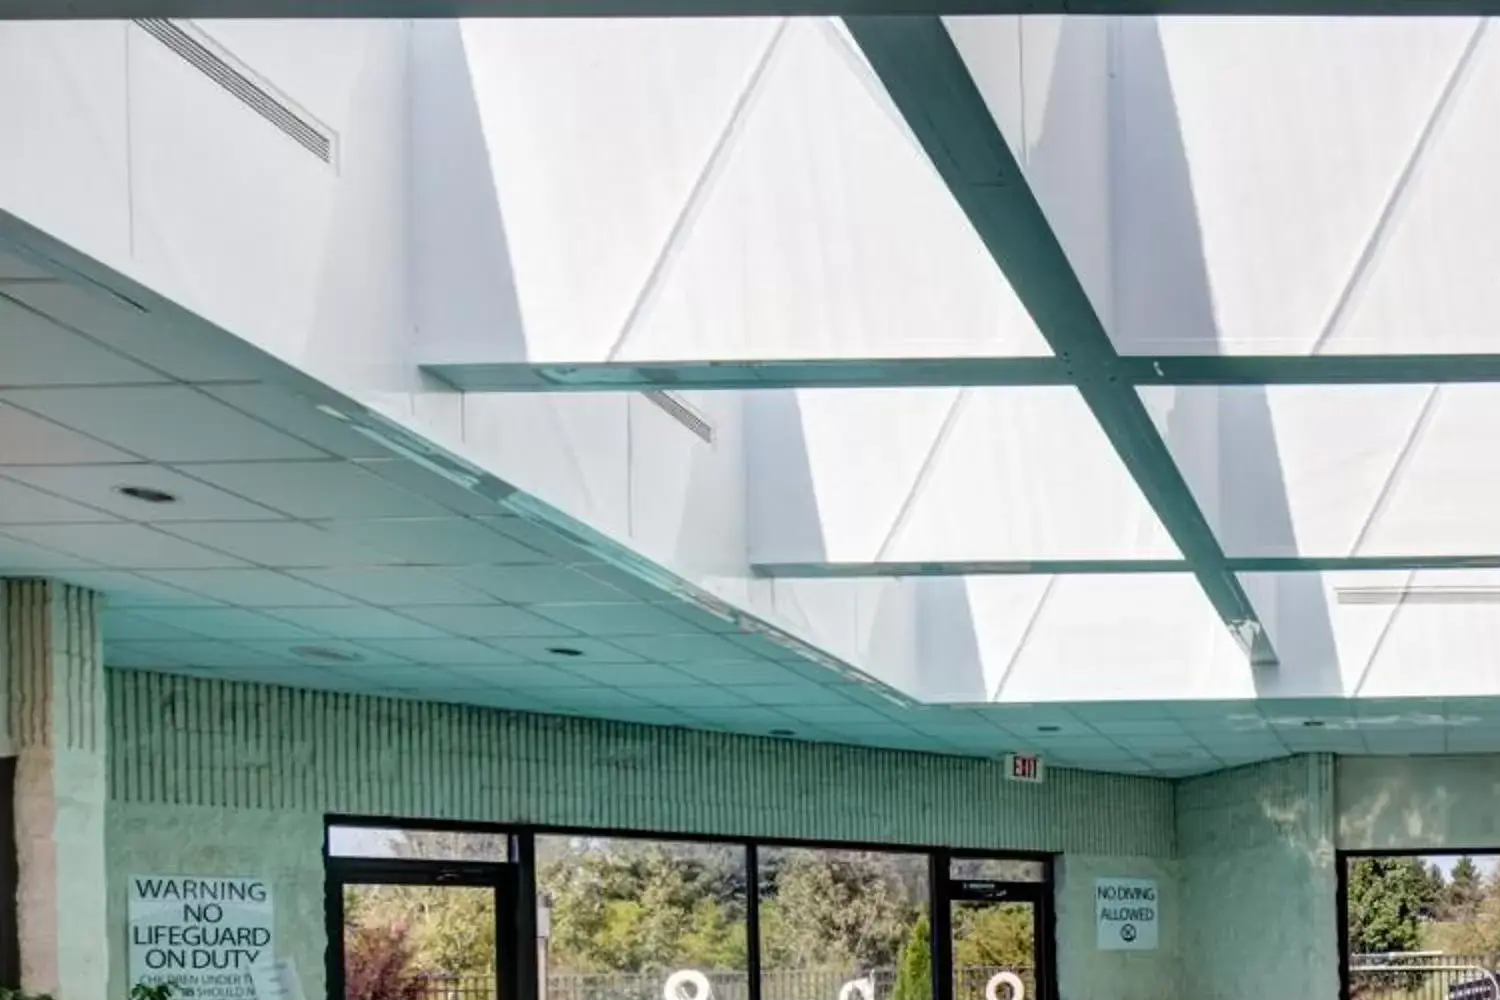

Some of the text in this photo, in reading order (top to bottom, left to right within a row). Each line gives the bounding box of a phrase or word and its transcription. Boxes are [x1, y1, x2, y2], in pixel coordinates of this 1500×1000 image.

[135, 879, 268, 902] WARNING
[1097, 885, 1155, 902] NO DIVING
[182, 903, 223, 923] NO
[1101, 907, 1154, 921] ALLOWED
[133, 925, 271, 947] LIFEGUARD
[145, 949, 260, 969] ON DUTY
[196, 986, 243, 998] SHOULD
